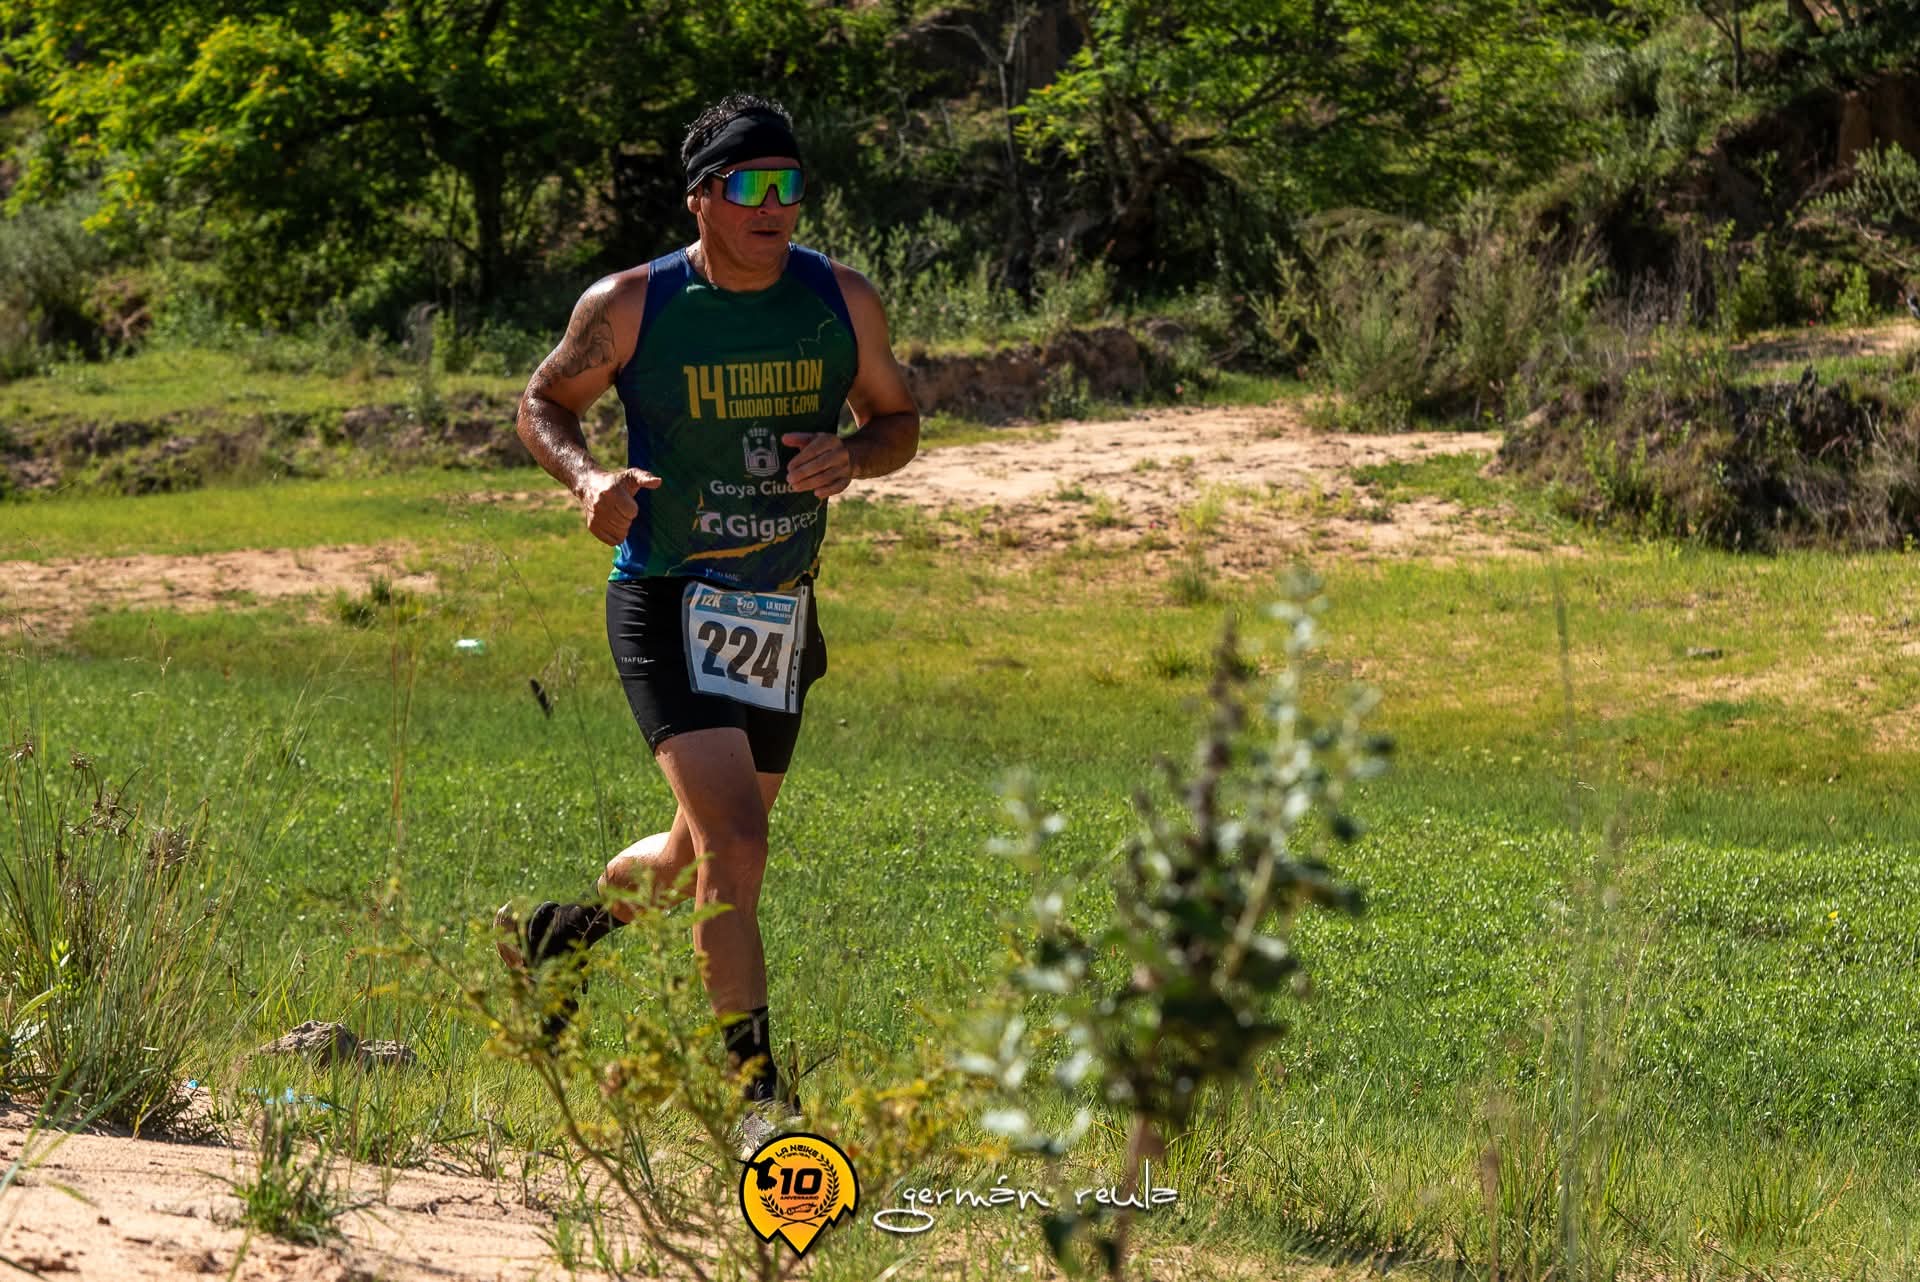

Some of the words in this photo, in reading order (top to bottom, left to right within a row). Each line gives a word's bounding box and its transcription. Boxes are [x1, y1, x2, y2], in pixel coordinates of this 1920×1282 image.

[683, 365, 727, 419] 14
[726, 359, 823, 395] TRIATLON
[729, 398, 773, 418] CIUDAD
[775, 397, 790, 416] DE
[792, 394, 819, 414] GOYA
[709, 480, 756, 498] Goya
[701, 592, 722, 608] 12K
[698, 620, 784, 688] 224
